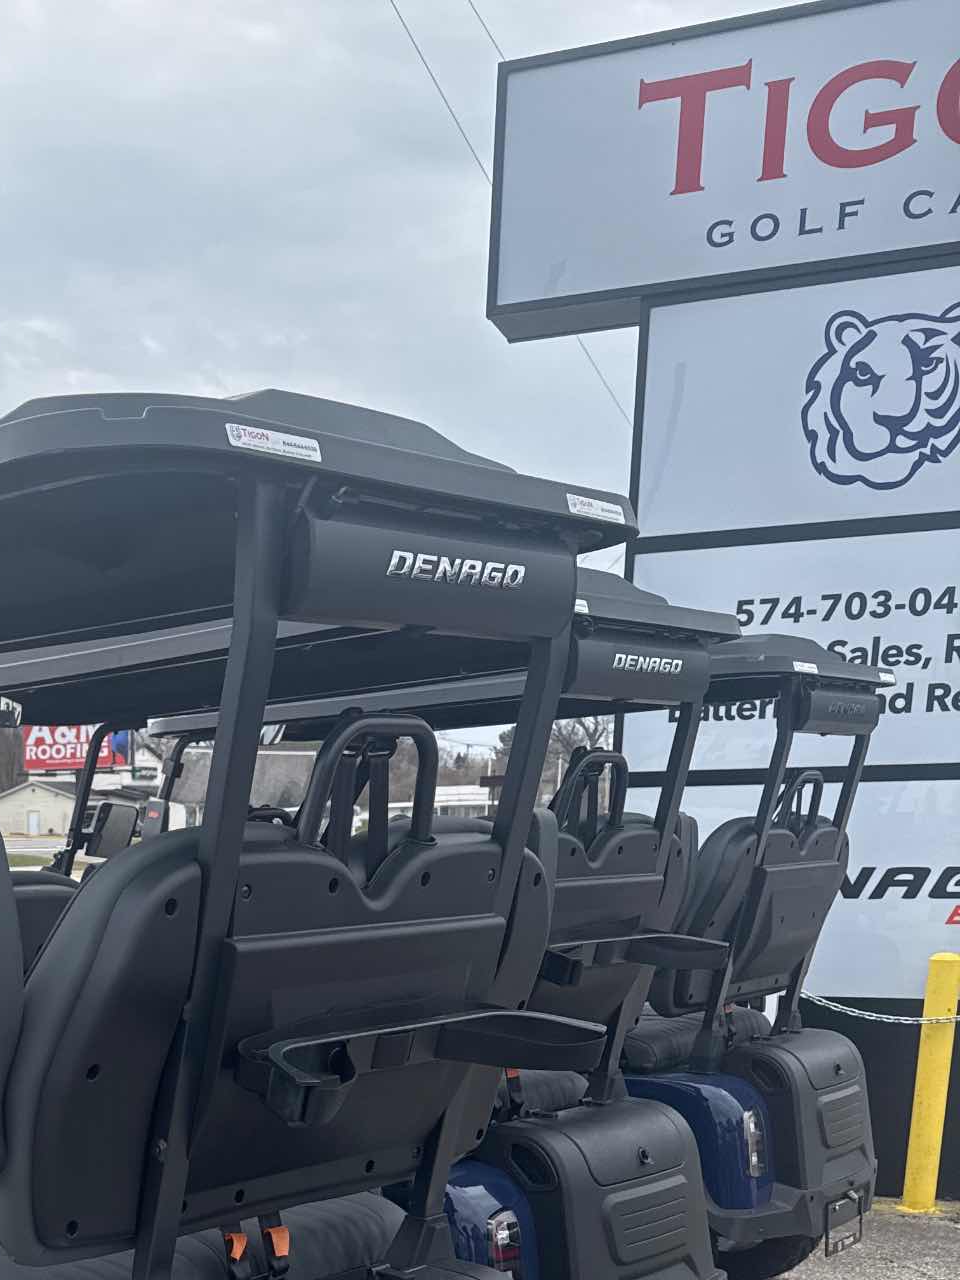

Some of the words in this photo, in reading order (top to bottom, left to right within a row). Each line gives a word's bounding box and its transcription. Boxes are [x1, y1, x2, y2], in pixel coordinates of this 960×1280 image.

[638, 58, 960, 196] TIG
[706, 199, 865, 249] GOLF
[386, 549, 526, 590] DENAGO
[613, 653, 683, 673] DENAGO
[668, 697, 778, 723] atter
